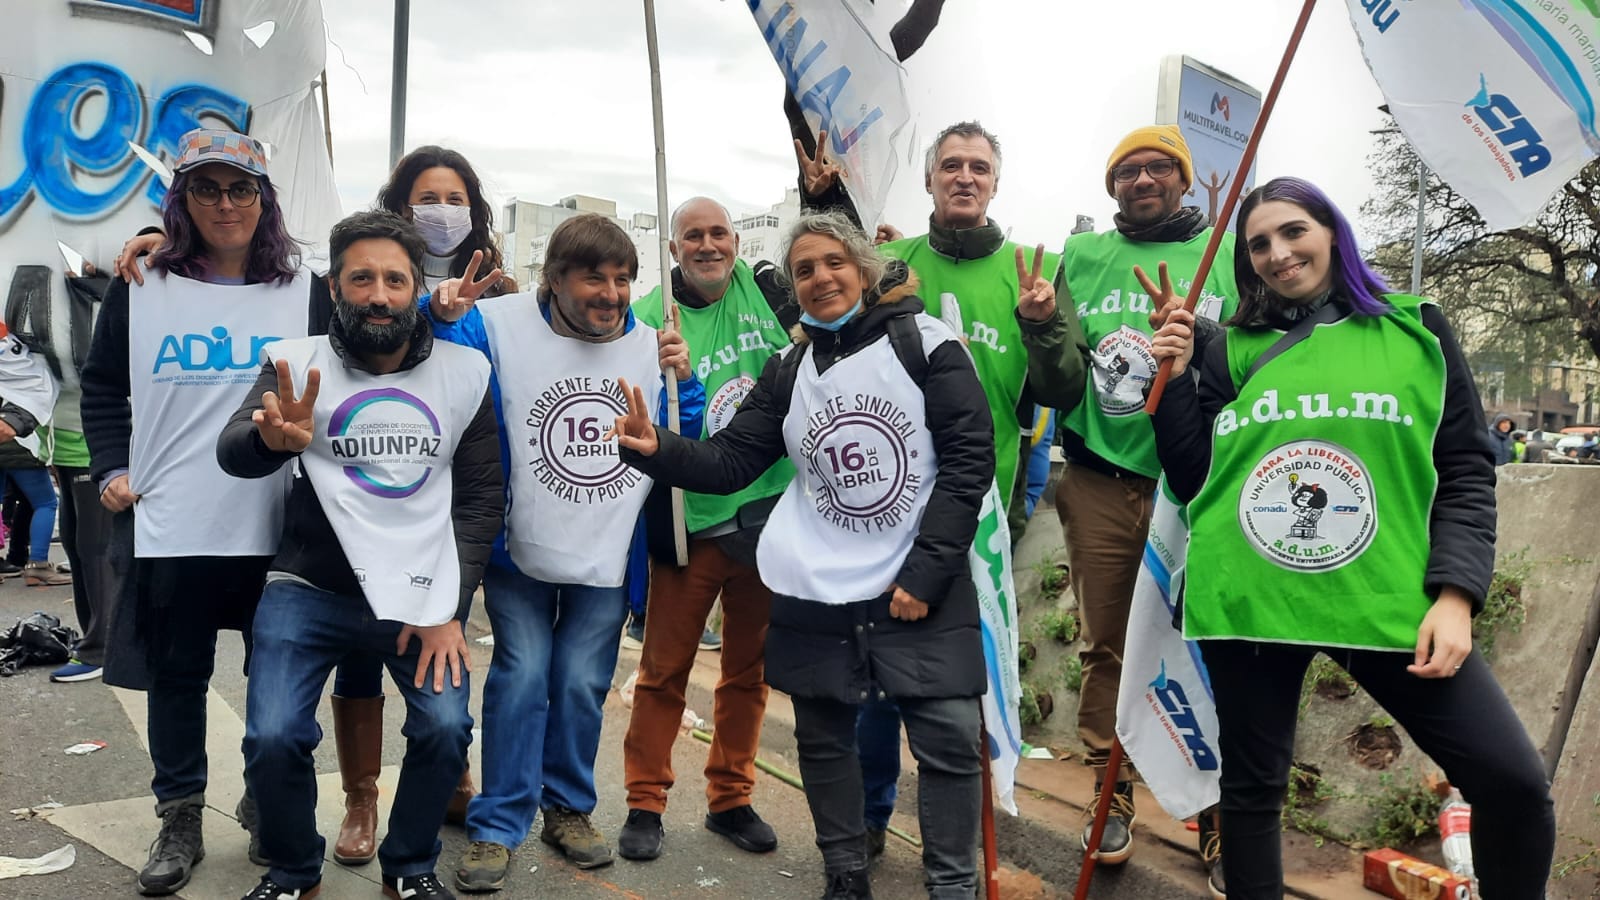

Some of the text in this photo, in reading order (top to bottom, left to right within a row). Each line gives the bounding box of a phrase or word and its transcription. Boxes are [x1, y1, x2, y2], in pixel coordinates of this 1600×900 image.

[1472, 123, 1485, 137] los
[1483, 136, 1516, 182] trabajadores
[526, 377, 593, 428] CORRIENTE
[855, 393, 916, 442] SINDICAL
[1217, 390, 1414, 436] a.d.u.m.
[331, 436, 441, 458] ADIUNPAZ
[563, 417, 600, 443] 16
[563, 444, 618, 458] ABRIL
[824, 442, 865, 474] 16
[1255, 447, 1361, 479] PARA LA LIBERTAD
[529, 457, 642, 504] FEDERAL Y POPUL
[1250, 460, 1366, 503] UNIVERSIDAD PUBLICA
[816, 473, 920, 534] FEDERAL Y POPULAR
[1252, 505, 1288, 513] conadu
[1273, 539, 1339, 558] a.d.u.m.
[1160, 715, 1193, 768] trabajadores
